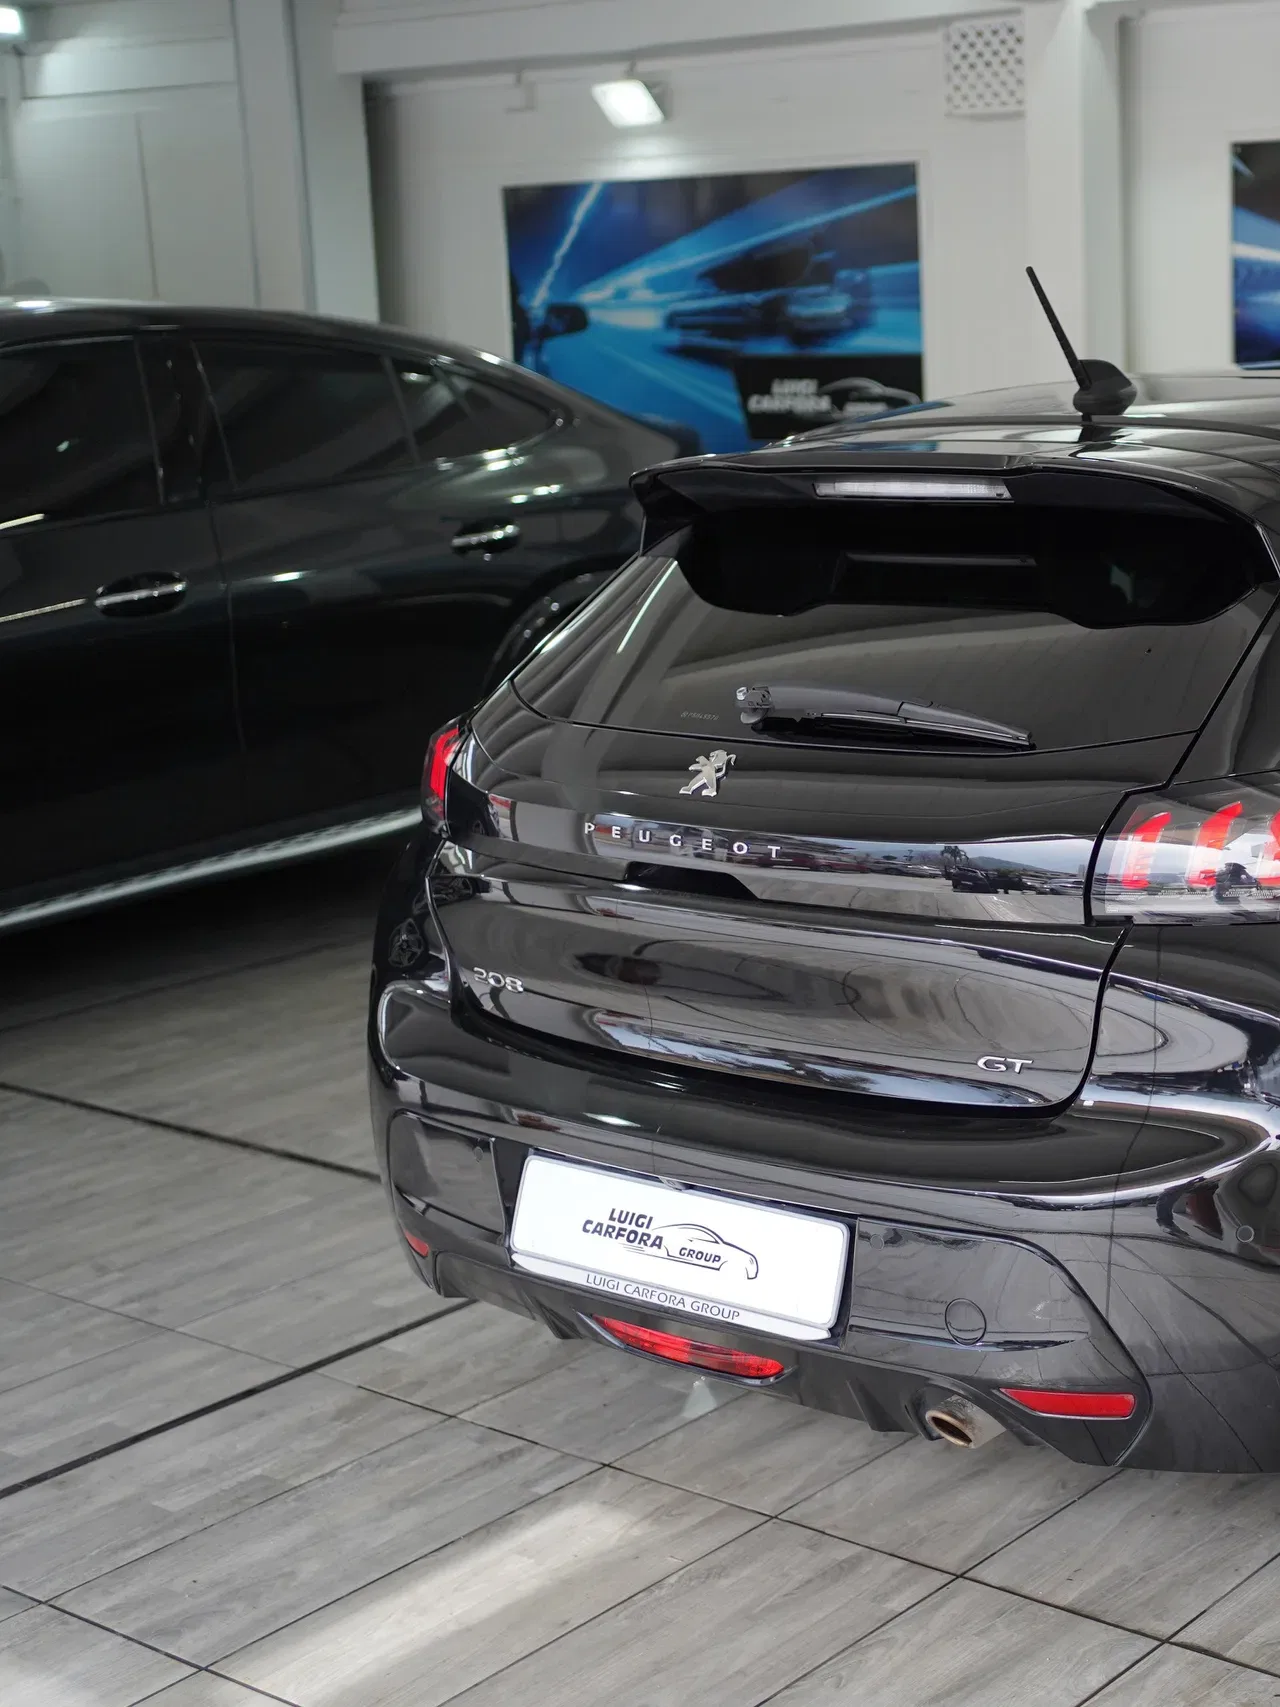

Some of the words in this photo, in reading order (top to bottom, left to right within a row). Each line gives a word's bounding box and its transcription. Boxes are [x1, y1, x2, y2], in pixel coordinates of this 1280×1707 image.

[584, 822, 781, 858] PEUGEOT
[473, 967, 524, 993] 208
[977, 1055, 1034, 1074] GT
[608, 1207, 653, 1229] LUIGI
[582, 1219, 664, 1250] CARFORA
[678, 1246, 722, 1264] GROUP
[586, 1273, 620, 1291] LUIGI
[623, 1283, 686, 1309] CARFORA
[690, 1300, 740, 1321] GROUP
